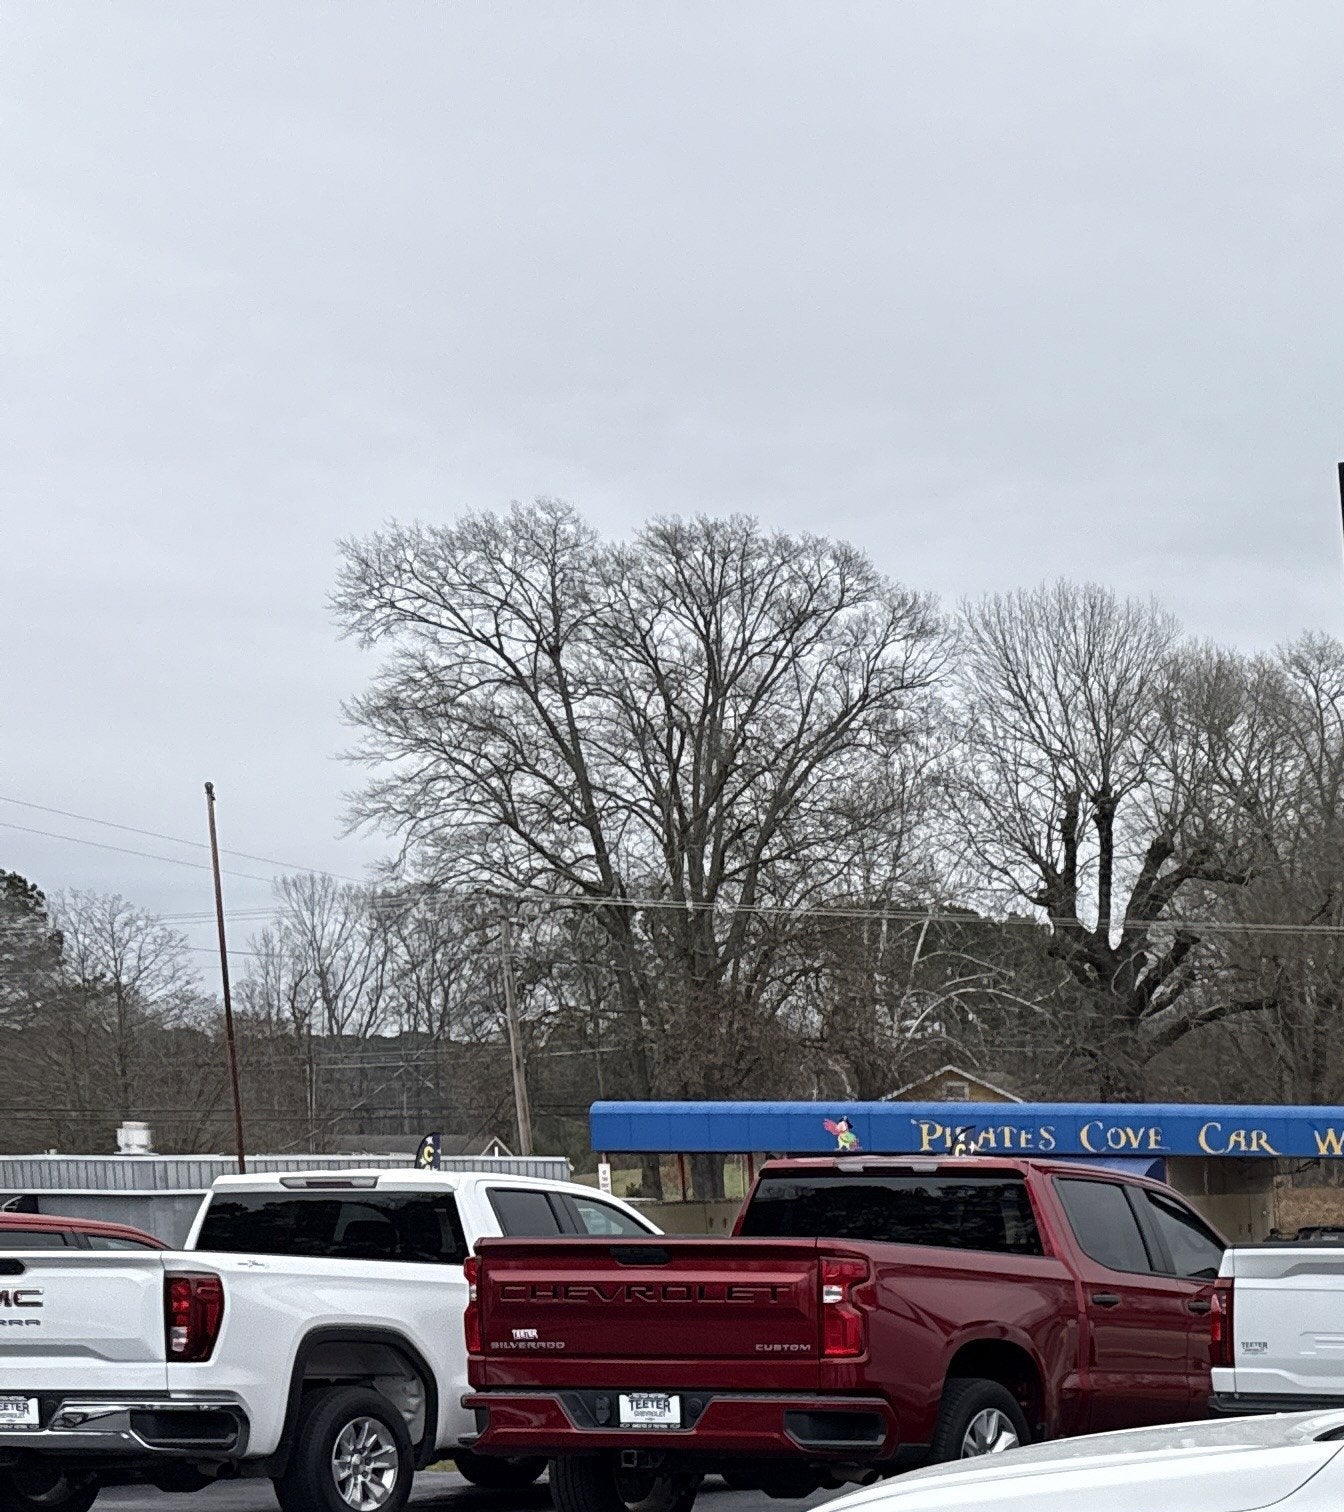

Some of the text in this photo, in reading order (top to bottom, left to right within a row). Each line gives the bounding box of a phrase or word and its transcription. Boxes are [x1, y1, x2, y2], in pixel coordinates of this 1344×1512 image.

[1080, 1120, 1170, 1153] COVE
[1198, 1121, 1283, 1156] CAR
[501, 1285, 791, 1303] CHEVROLET
[491, 1341, 566, 1350] SILVERADO
[755, 1343, 811, 1352] CUSTOM
[628, 1399, 672, 1414] TEETER
